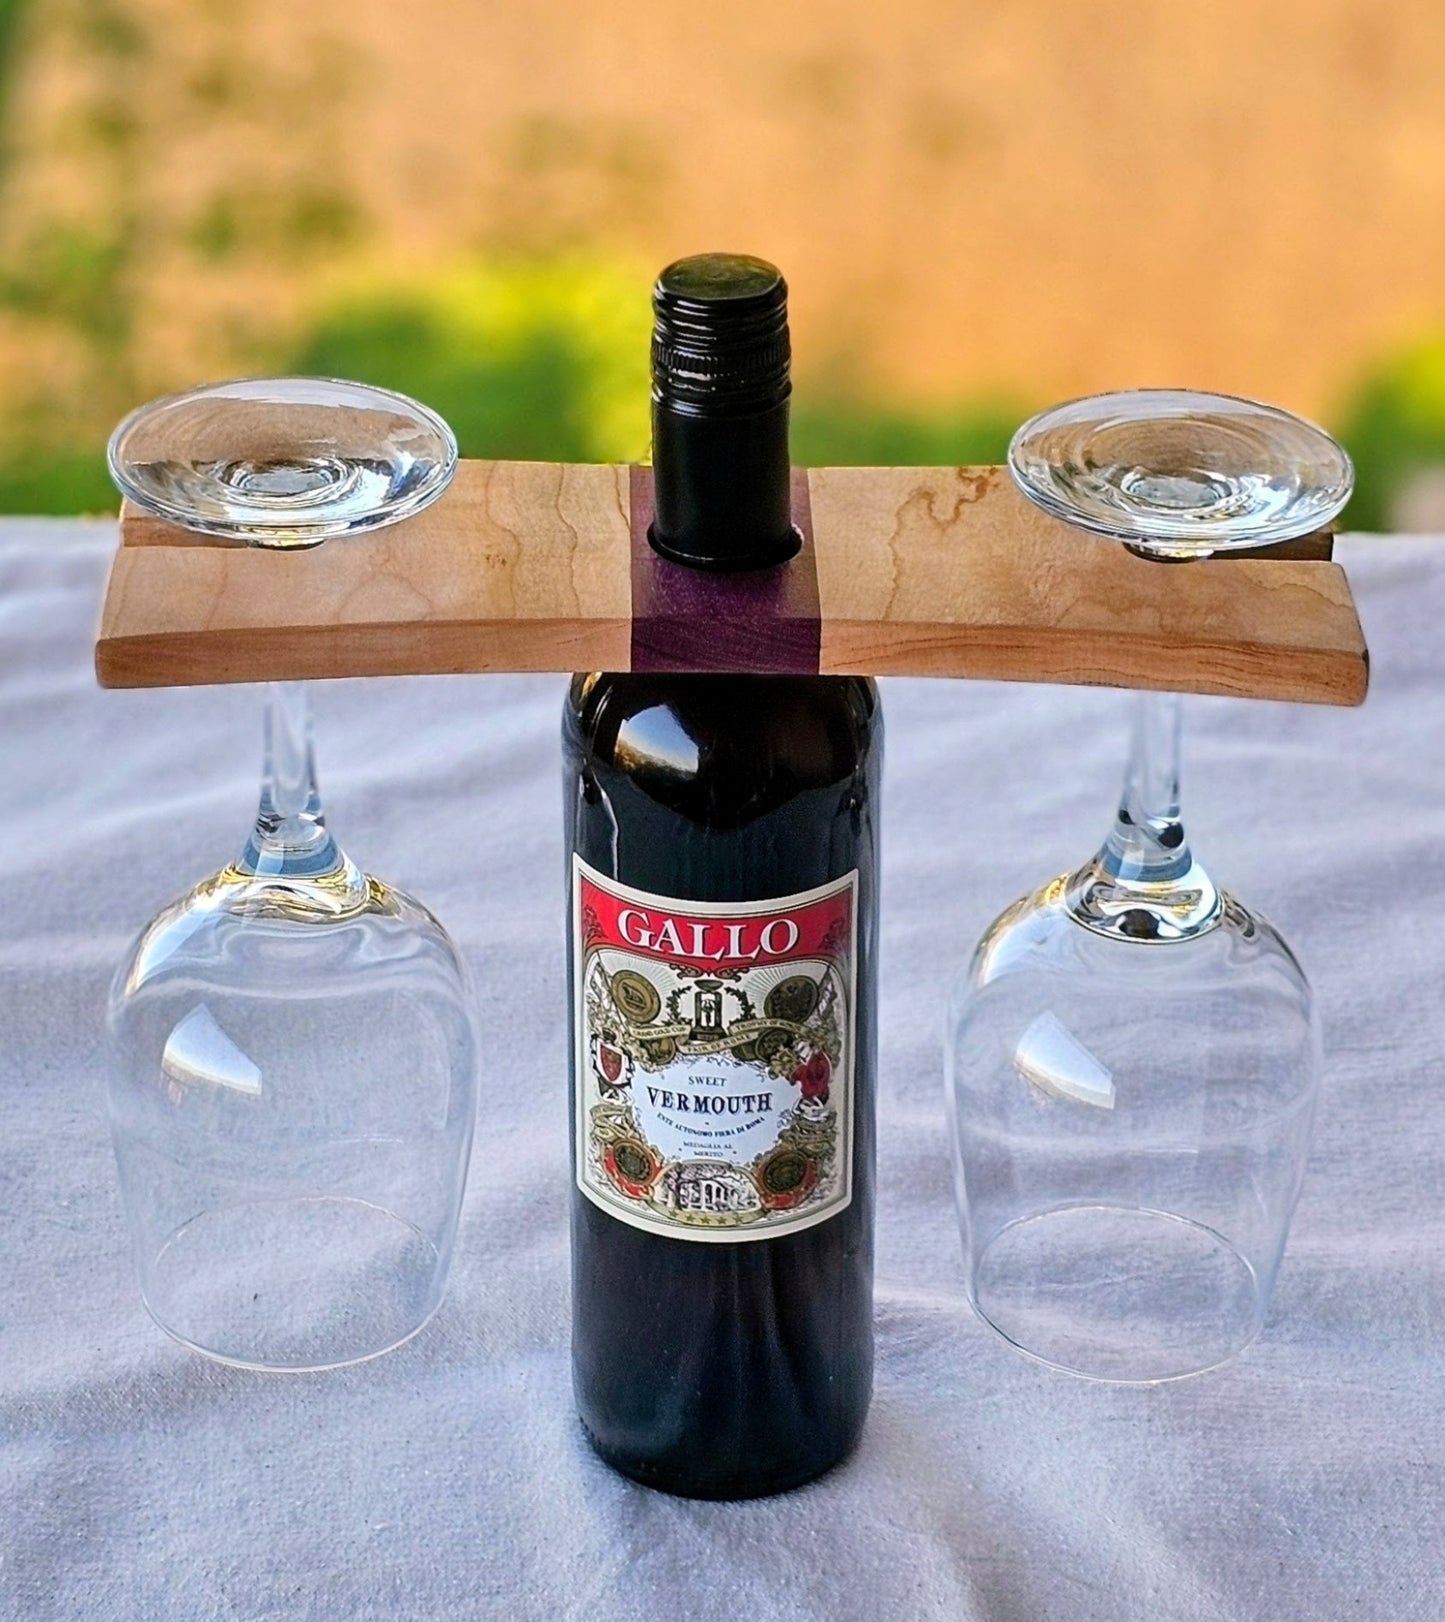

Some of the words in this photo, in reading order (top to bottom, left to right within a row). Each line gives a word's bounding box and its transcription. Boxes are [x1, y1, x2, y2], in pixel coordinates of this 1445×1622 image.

[617, 908, 799, 961] GALLO
[688, 1075, 727, 1087] SWEET
[646, 1085, 773, 1115] VERMOUTH
